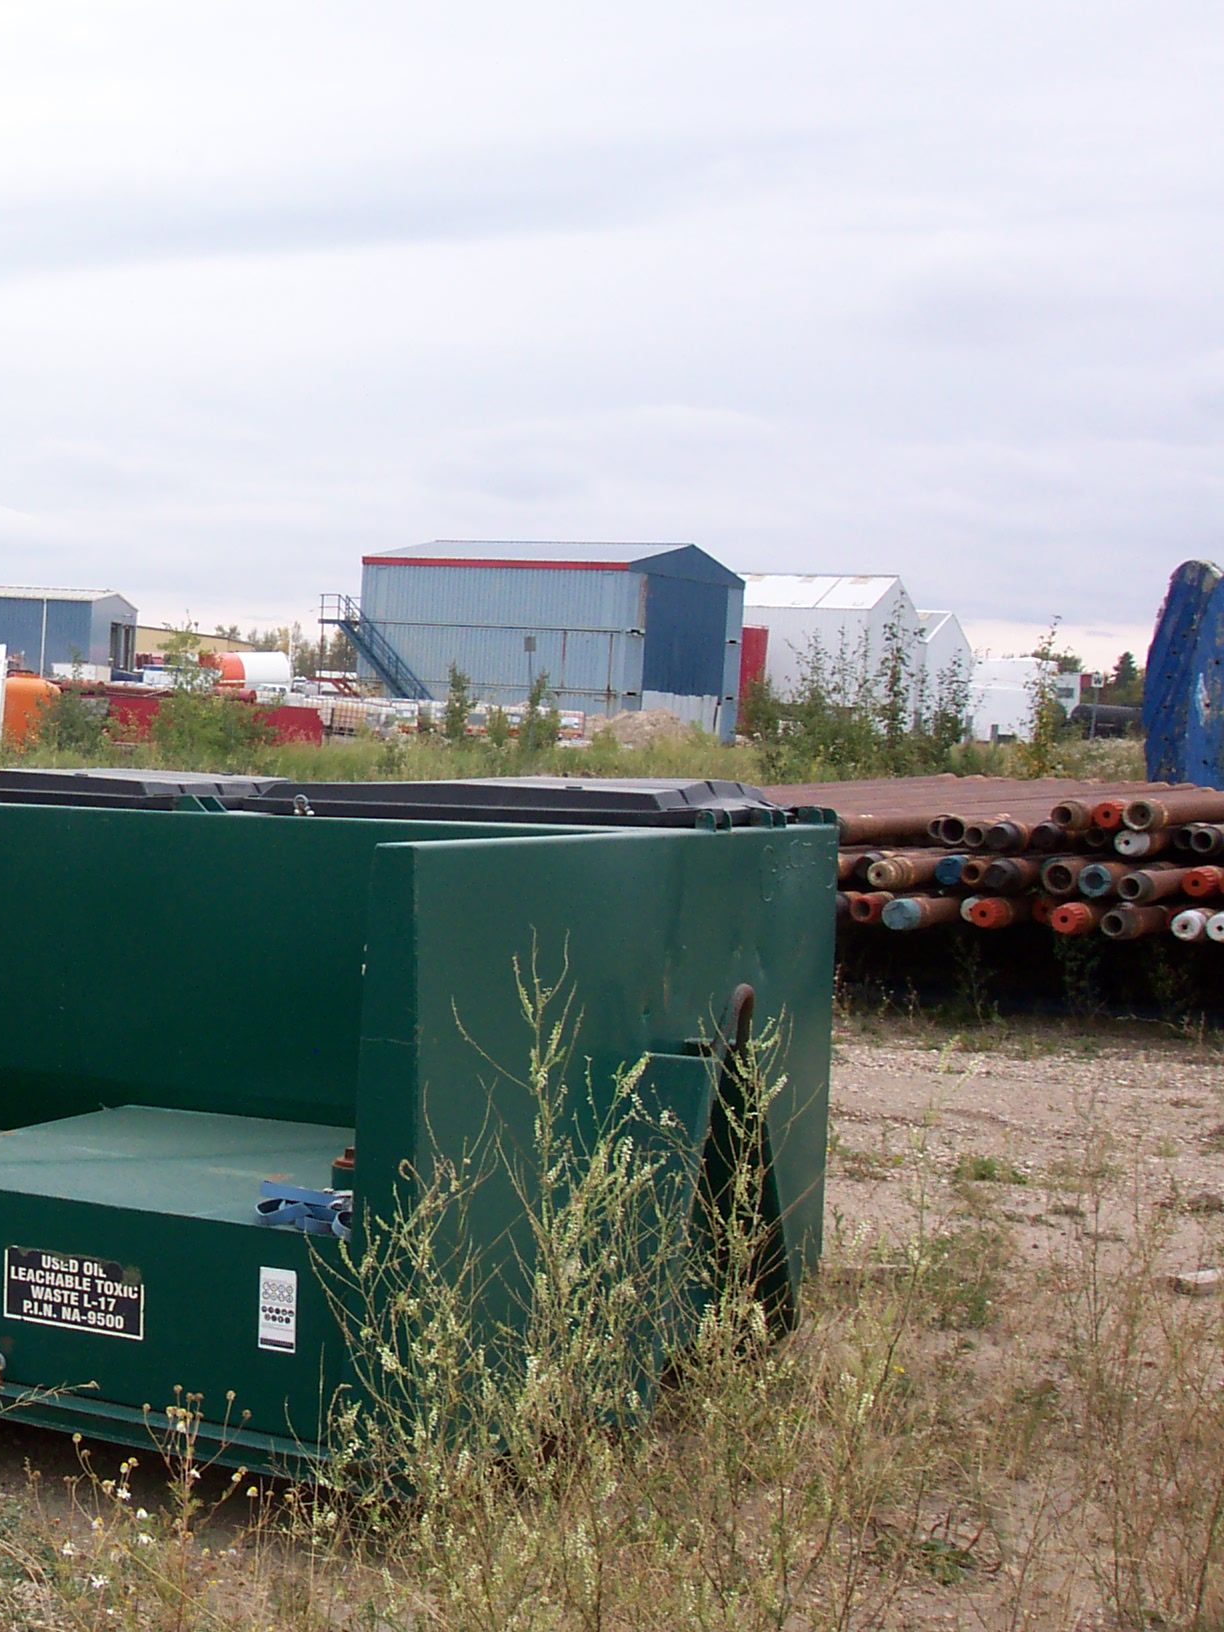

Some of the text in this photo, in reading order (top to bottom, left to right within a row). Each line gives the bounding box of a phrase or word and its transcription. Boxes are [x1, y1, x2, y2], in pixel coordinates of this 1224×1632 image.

[41, 1255, 107, 1278] USED OIL
[10, 1266, 138, 1299] LEACHABLE TOXIC
[31, 1285, 116, 1311] WASTE L-17
[23, 1300, 124, 1329] P.I.N. NA-9500
